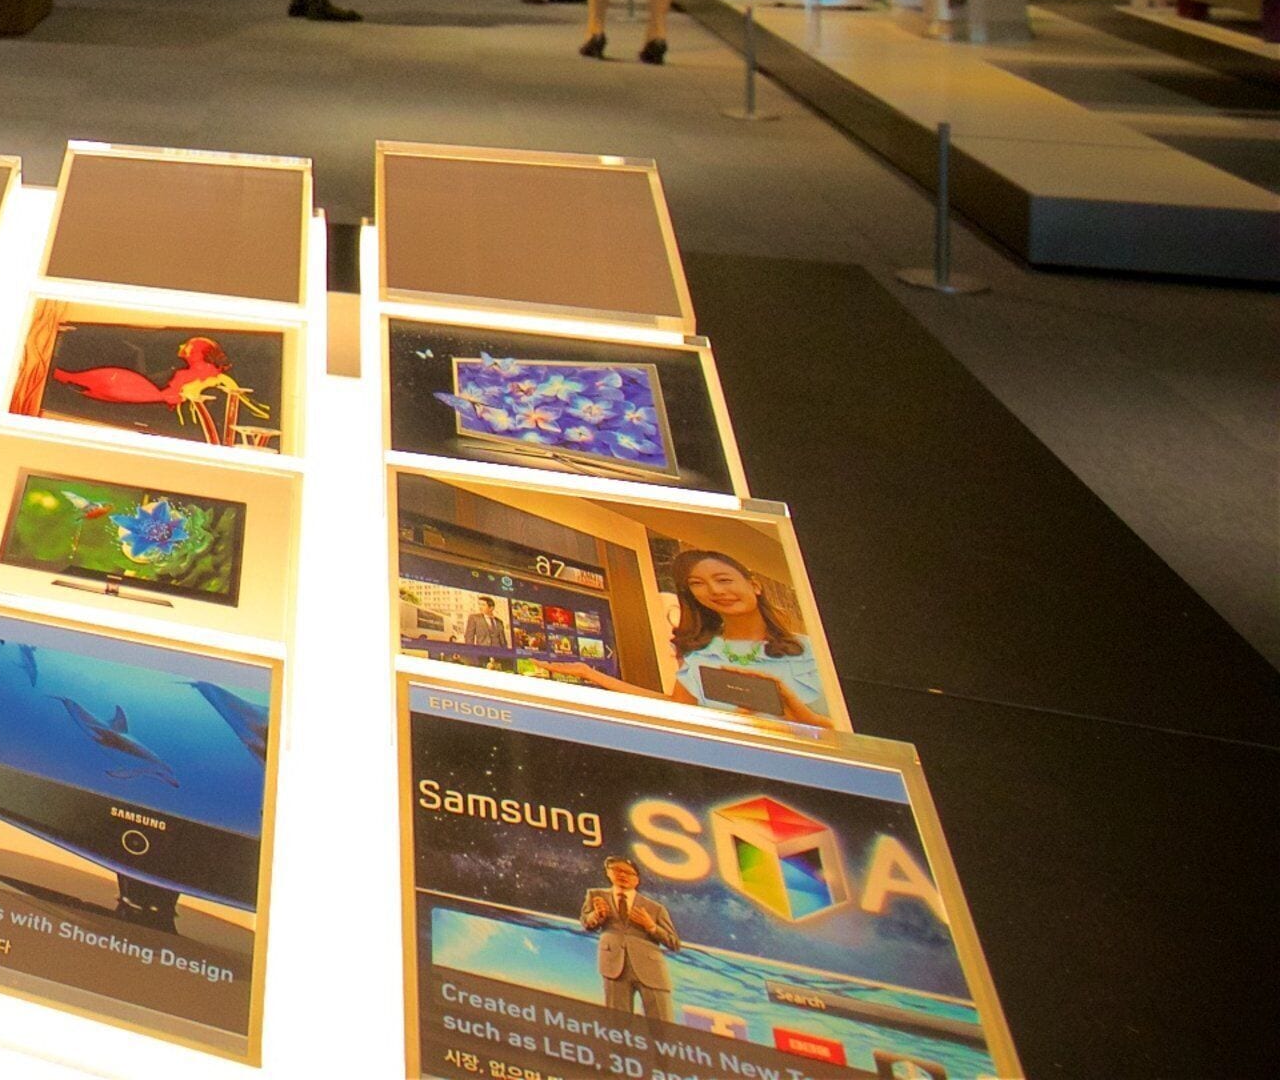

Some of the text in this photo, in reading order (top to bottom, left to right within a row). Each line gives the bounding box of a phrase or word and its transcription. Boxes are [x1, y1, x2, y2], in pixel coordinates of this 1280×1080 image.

[428, 696, 513, 723] EPISODE
[110, 806, 167, 831] SAMSUNG
[418, 779, 603, 848] Samsung
[10, 910, 53, 935] with
[58, 921, 154, 965] Shocking
[159, 948, 234, 984] Design
[774, 988, 827, 1011] Search
[441, 982, 780, 1080] Created Markets with New
[443, 1014, 501, 1042] such
[507, 1031, 537, 1051] as
[543, 1036, 602, 1070] LED,
[608, 1053, 644, 1078] 3D
[444, 1048, 485, 1074] 시장,
